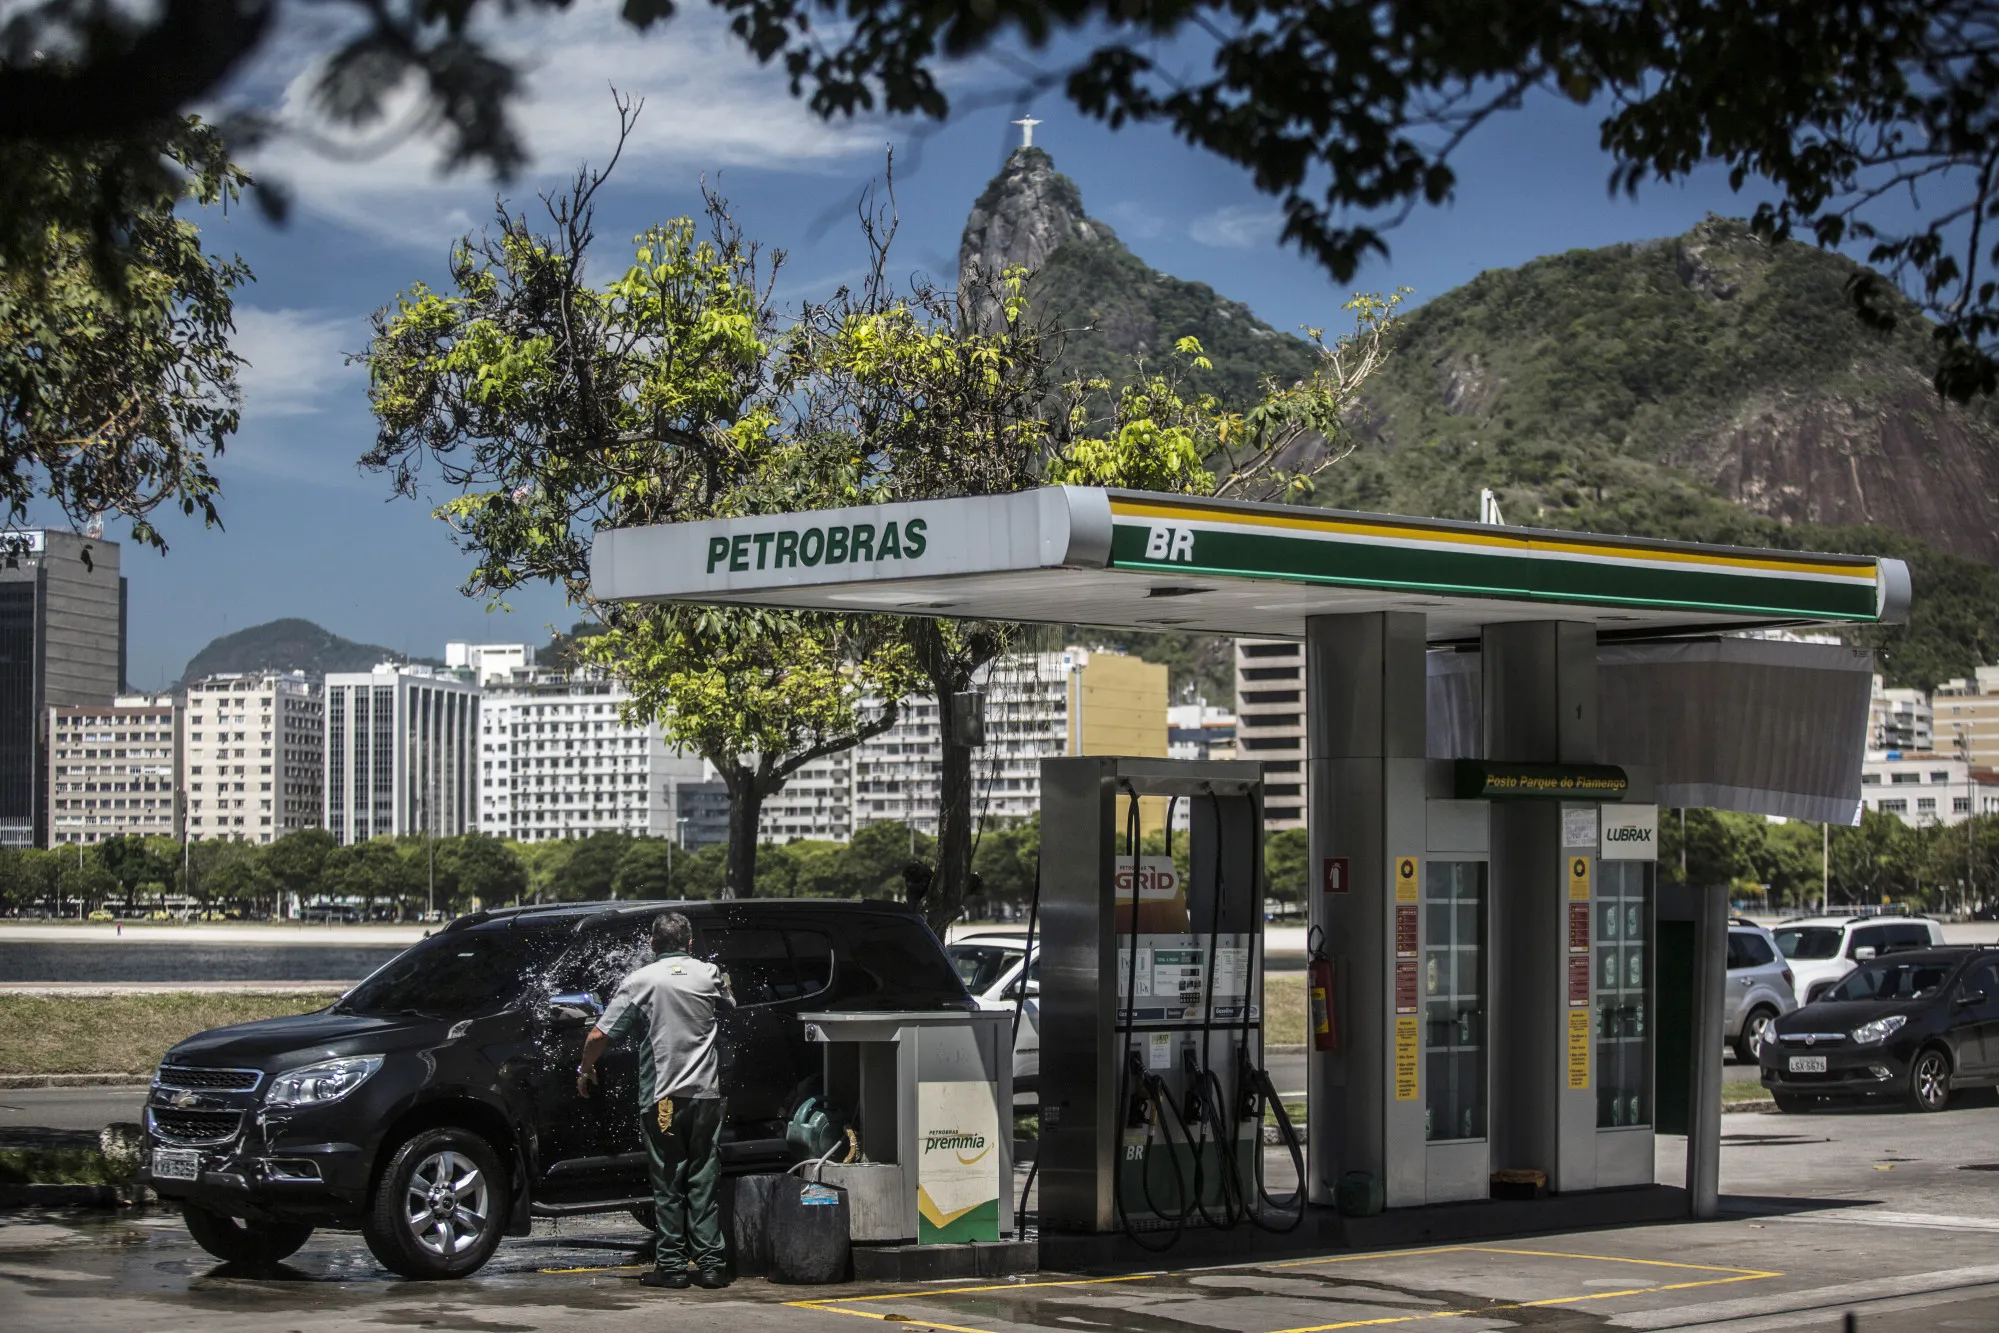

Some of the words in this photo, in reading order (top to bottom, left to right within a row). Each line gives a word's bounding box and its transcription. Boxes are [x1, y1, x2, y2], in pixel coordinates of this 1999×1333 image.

[706, 518, 928, 574] PETROBRAS
[1144, 526, 1195, 562] BR
[1486, 774, 1517, 787] Posto
[1520, 775, 1557, 789] Parque
[1560, 776, 1574, 788] do
[1576, 776, 1626, 791] Flamengo
[1607, 828, 1652, 842] LUBRAX
[1115, 873, 1174, 890] GRID
[925, 1133, 985, 1155] premmia
[1126, 1145, 1144, 1160] BR
